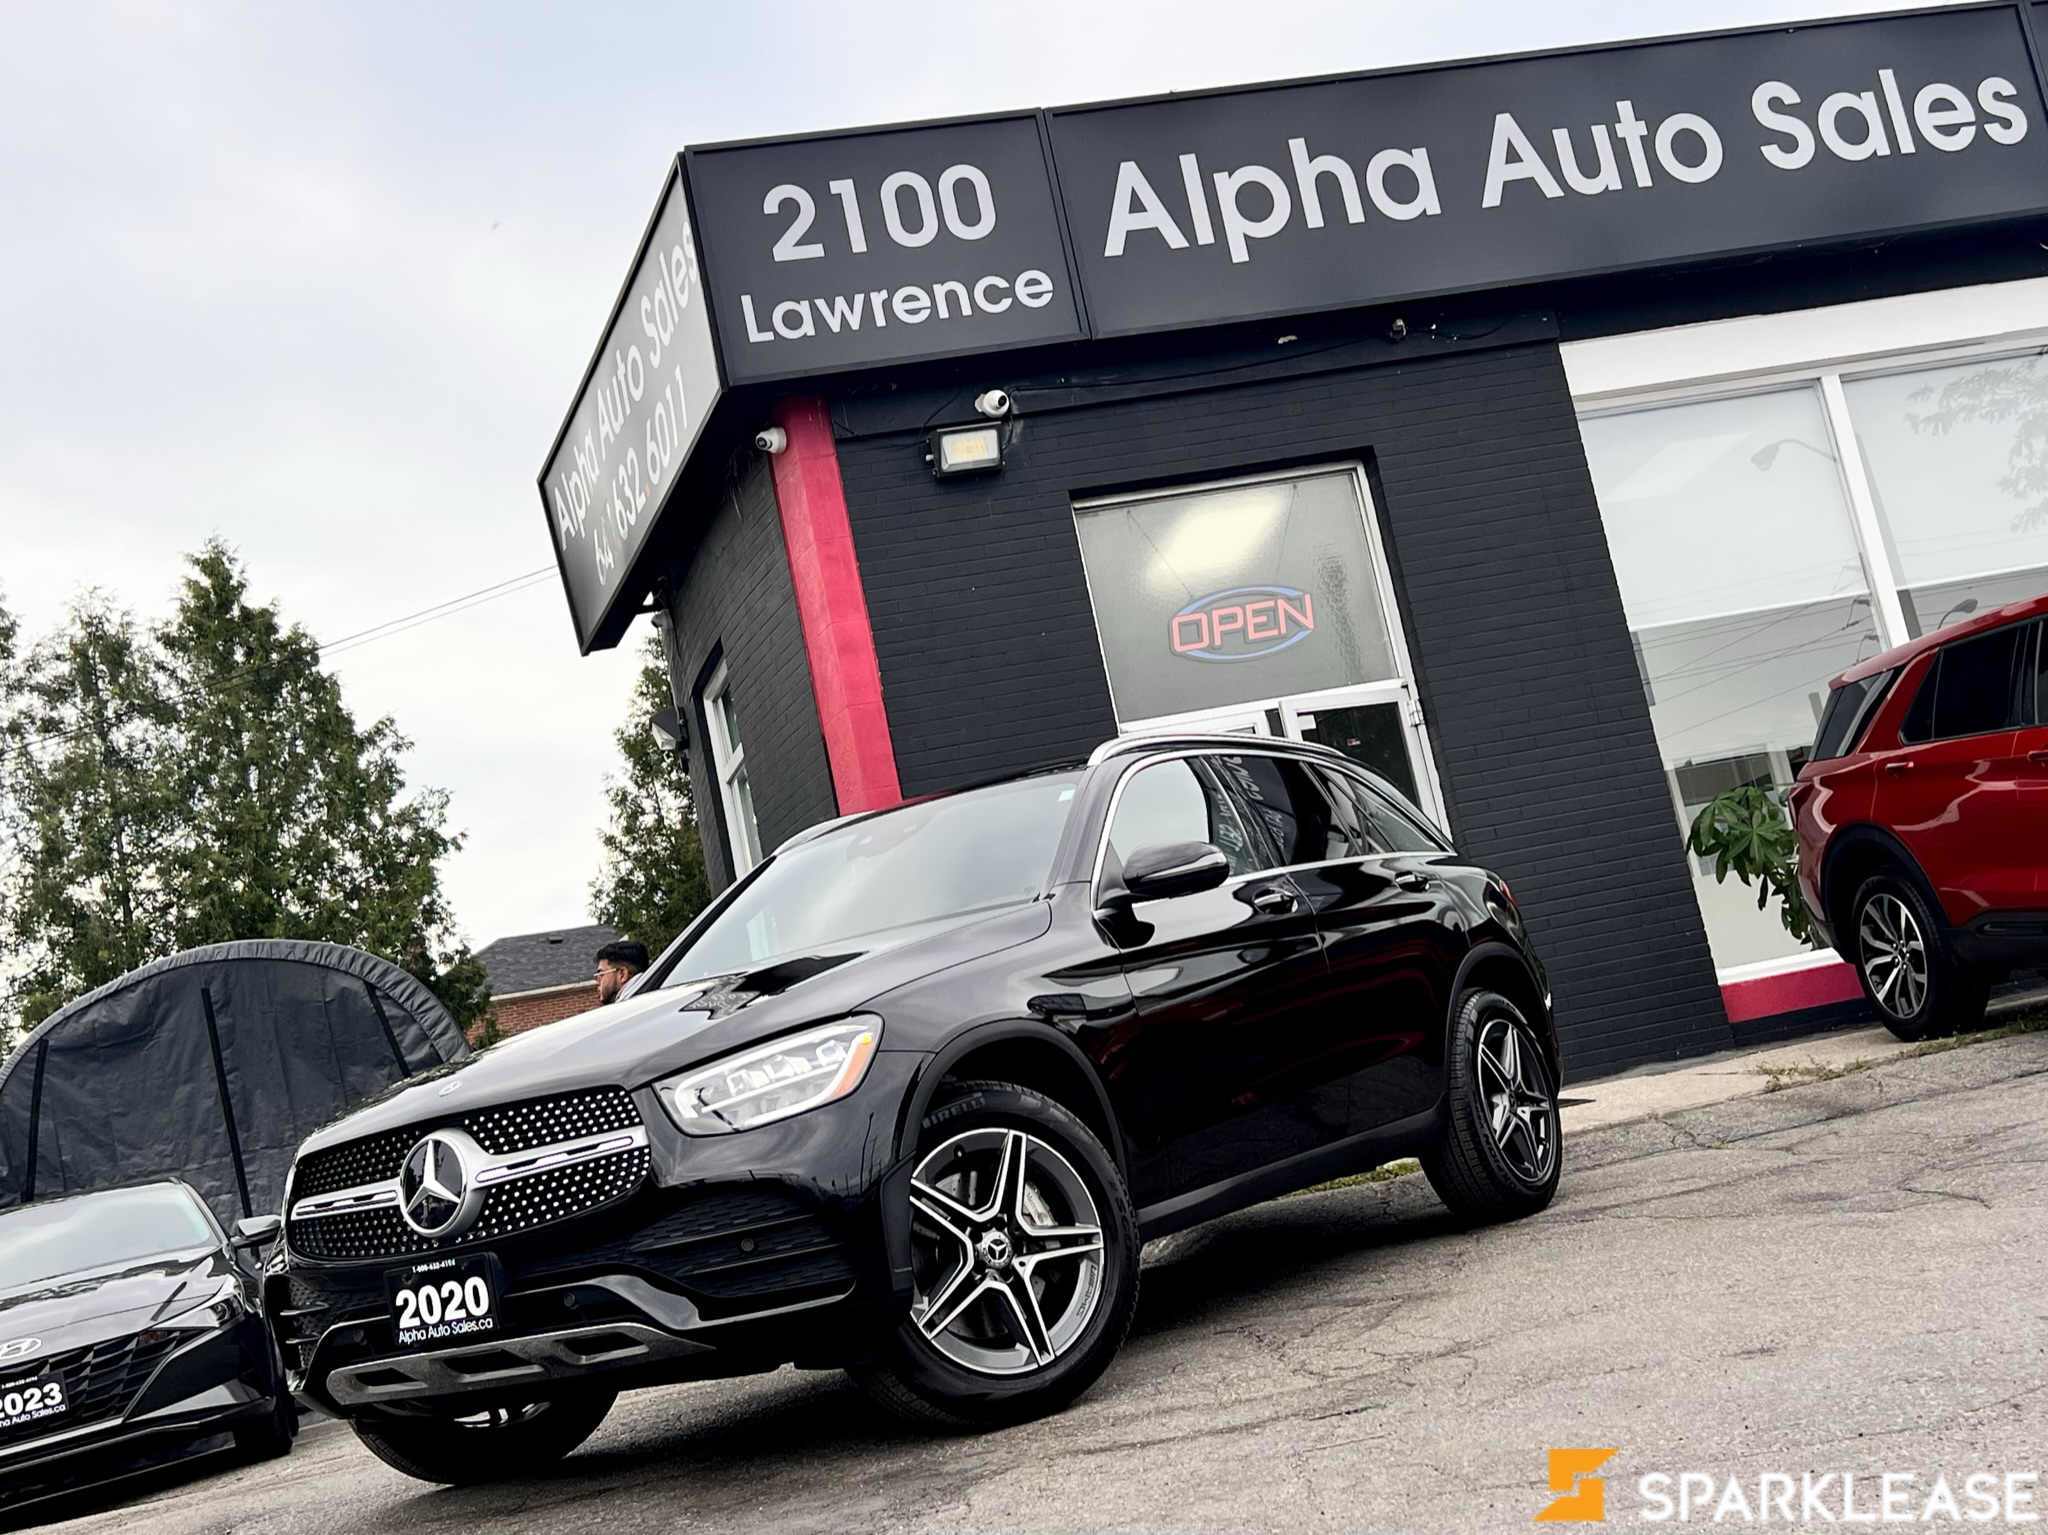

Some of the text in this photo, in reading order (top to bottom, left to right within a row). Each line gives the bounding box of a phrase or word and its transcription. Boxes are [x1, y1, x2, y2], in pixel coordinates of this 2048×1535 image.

[1103, 68, 2028, 264] Alpha Auto Sales
[762, 163, 998, 263] 2100
[739, 269, 1054, 344] Lawrence
[555, 221, 699, 550] Alpha Auto Sales
[1171, 592, 1315, 653] OPEN
[395, 1276, 490, 1329] 2020
[399, 1318, 493, 1345] Alpha Auto Sales.ca
[0, 1382, 63, 1419] 023
[12, 1413, 31, 1425] Auto
[31, 1404, 66, 1419] Sales.ca
